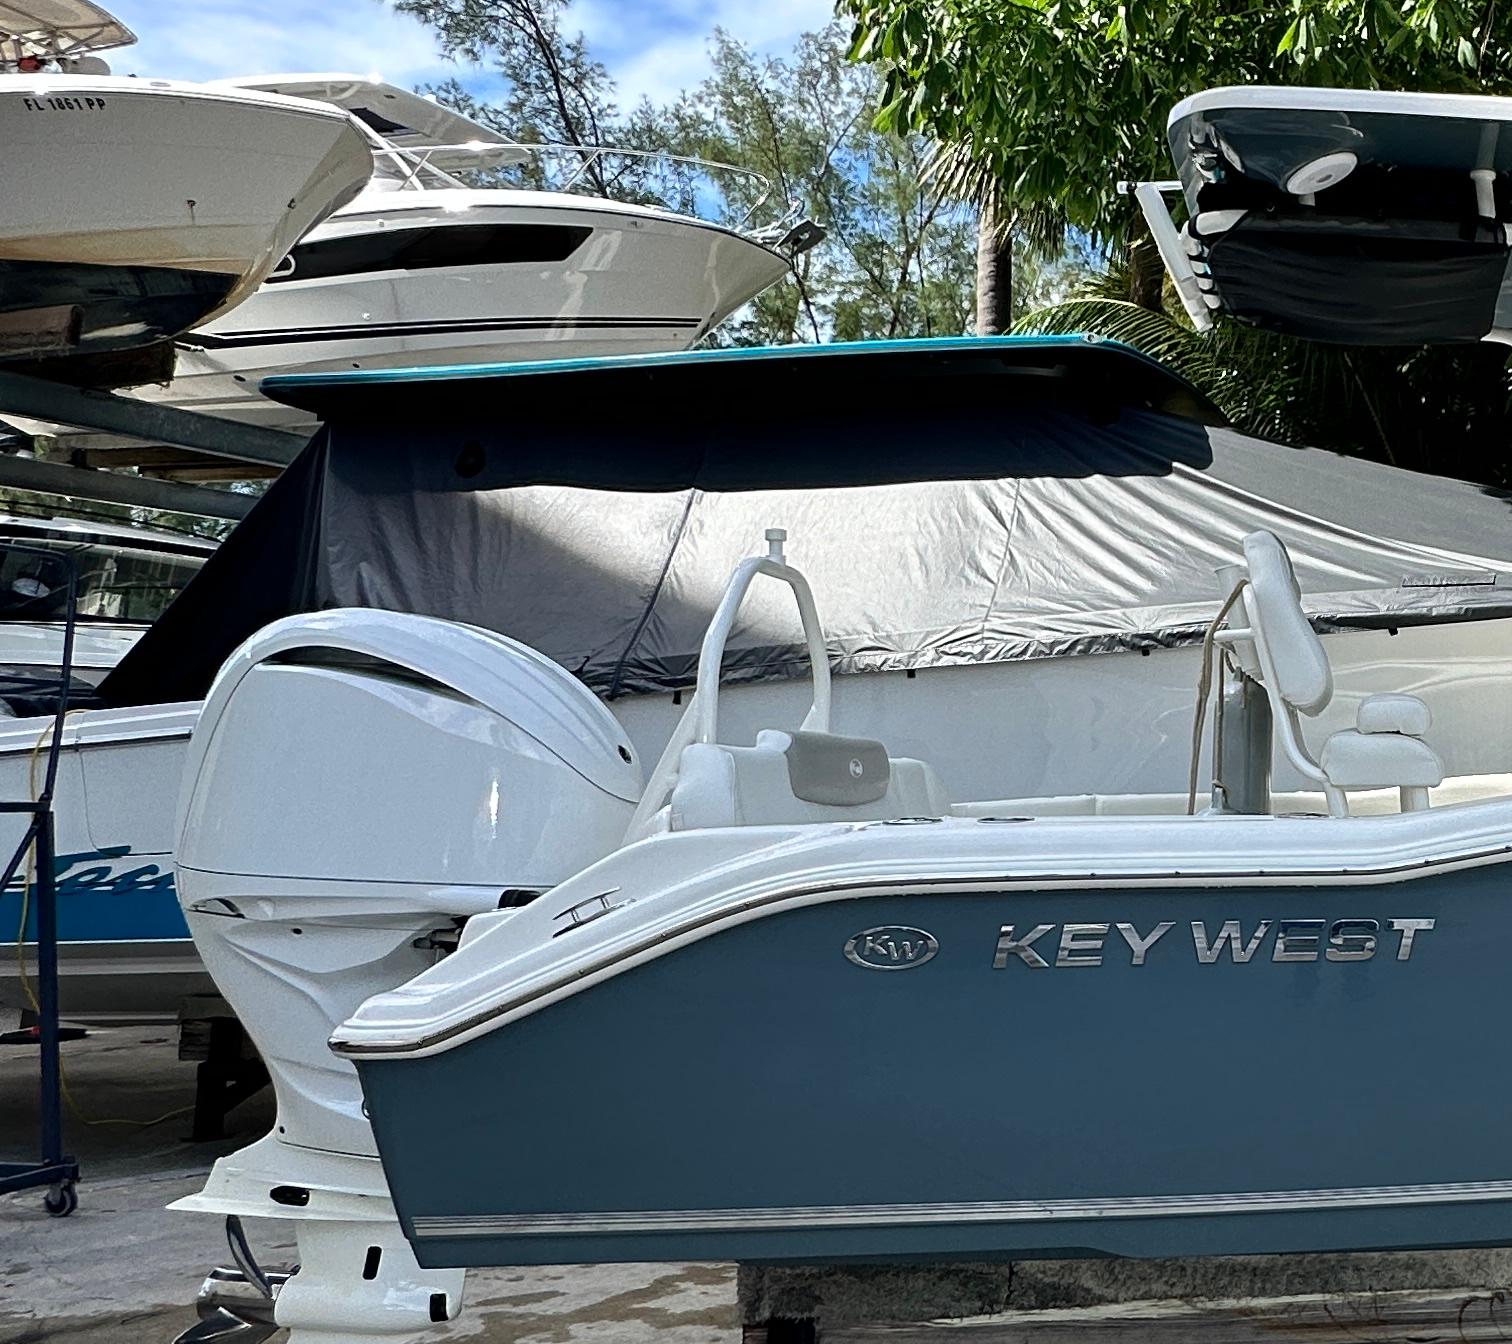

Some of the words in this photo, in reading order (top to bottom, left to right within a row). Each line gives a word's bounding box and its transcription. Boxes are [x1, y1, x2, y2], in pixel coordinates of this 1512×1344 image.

[23, 98, 45, 111] FL
[47, 97, 83, 111] 1861
[84, 97, 106, 111] PP
[863, 935, 924, 961] KW
[993, 921, 1176, 968] KEY
[1190, 918, 1437, 963] WEST
